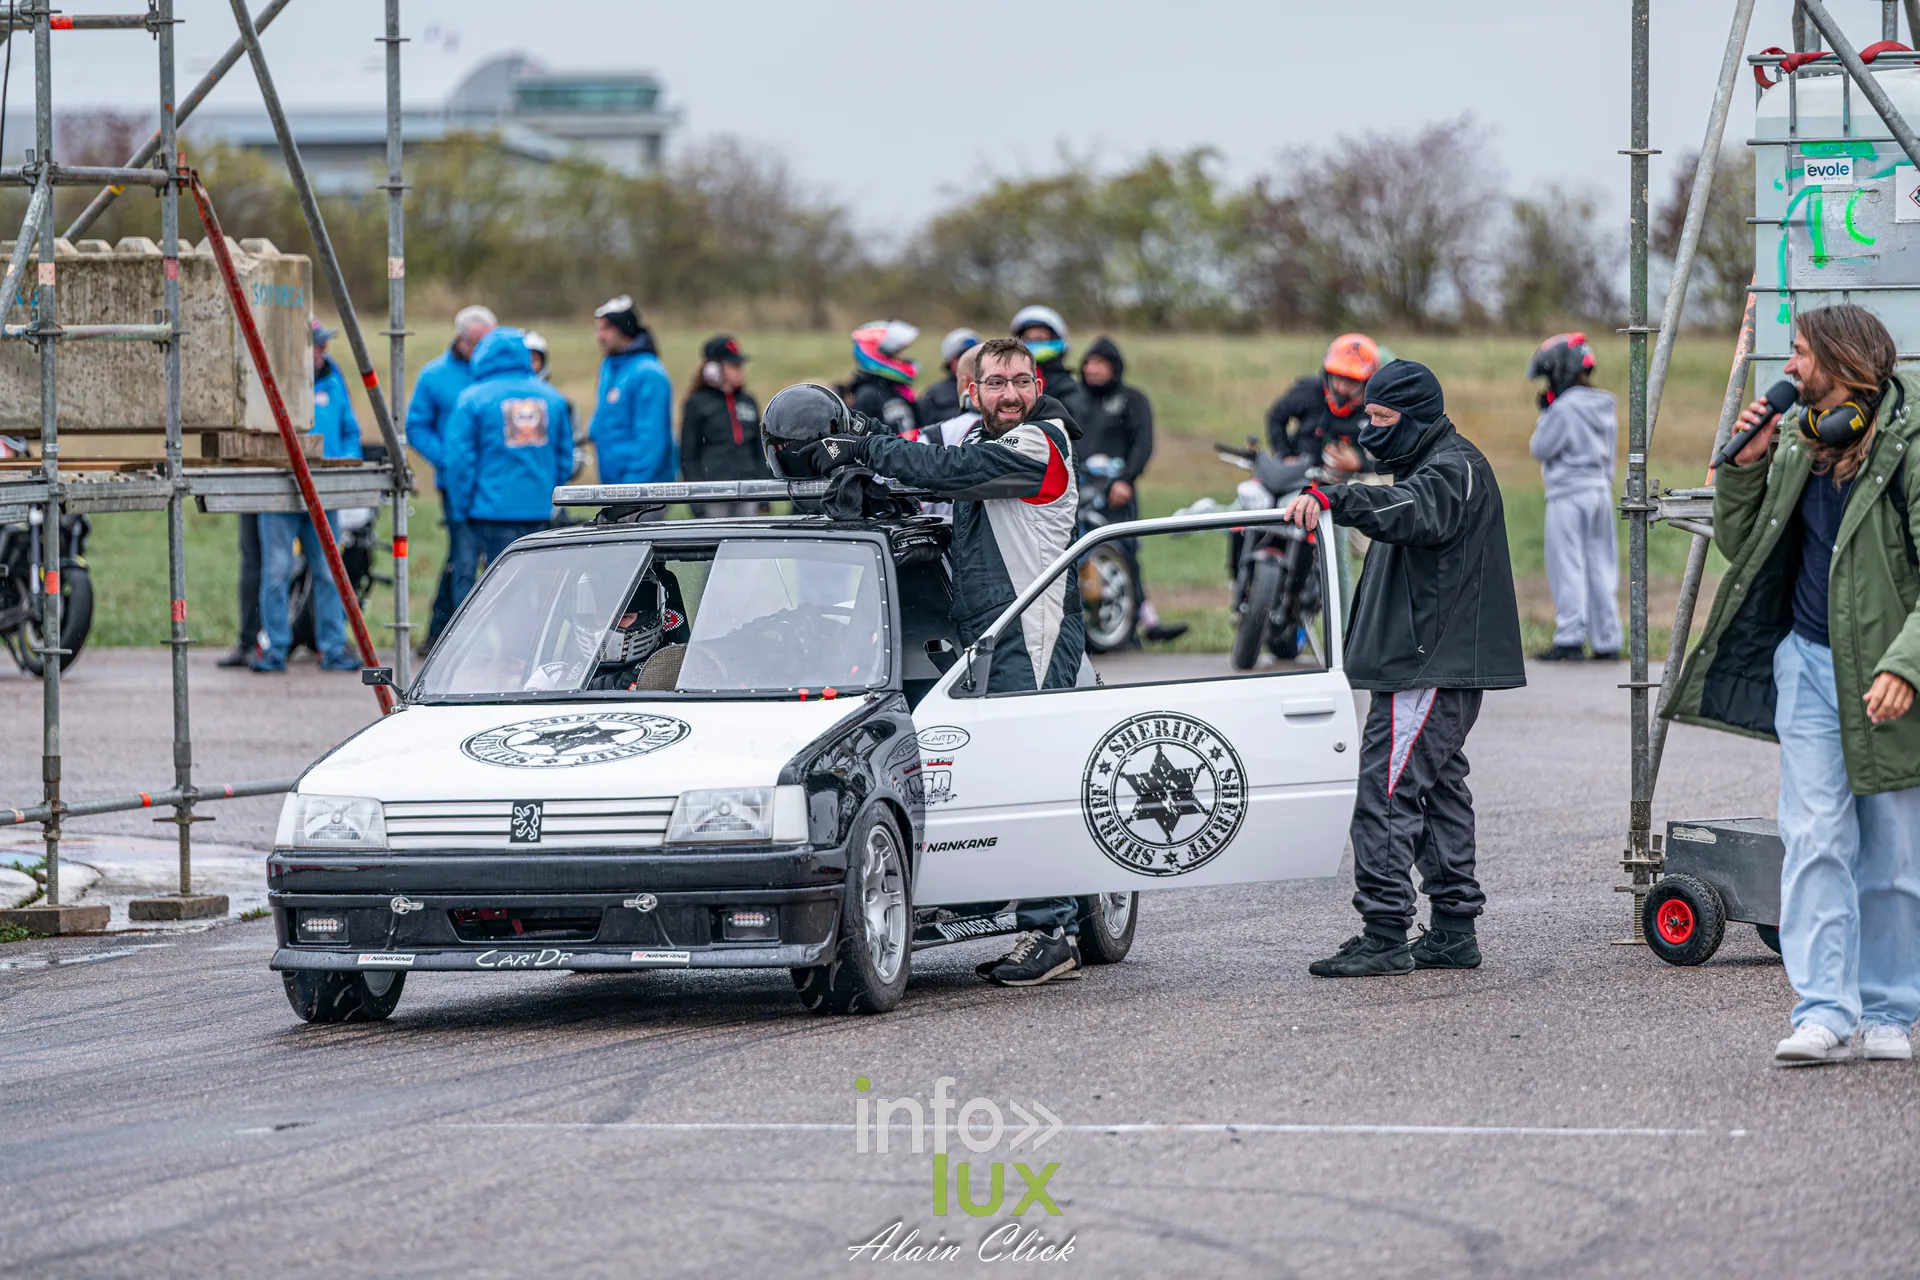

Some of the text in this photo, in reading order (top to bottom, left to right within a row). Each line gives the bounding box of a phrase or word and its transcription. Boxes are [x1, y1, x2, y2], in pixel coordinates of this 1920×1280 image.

[1108, 719, 1210, 758] SHERIFF
[926, 837, 998, 853] NANKANG
[1090, 783, 1156, 866] SHERIFF
[1188, 767, 1240, 862] SHERIFF
